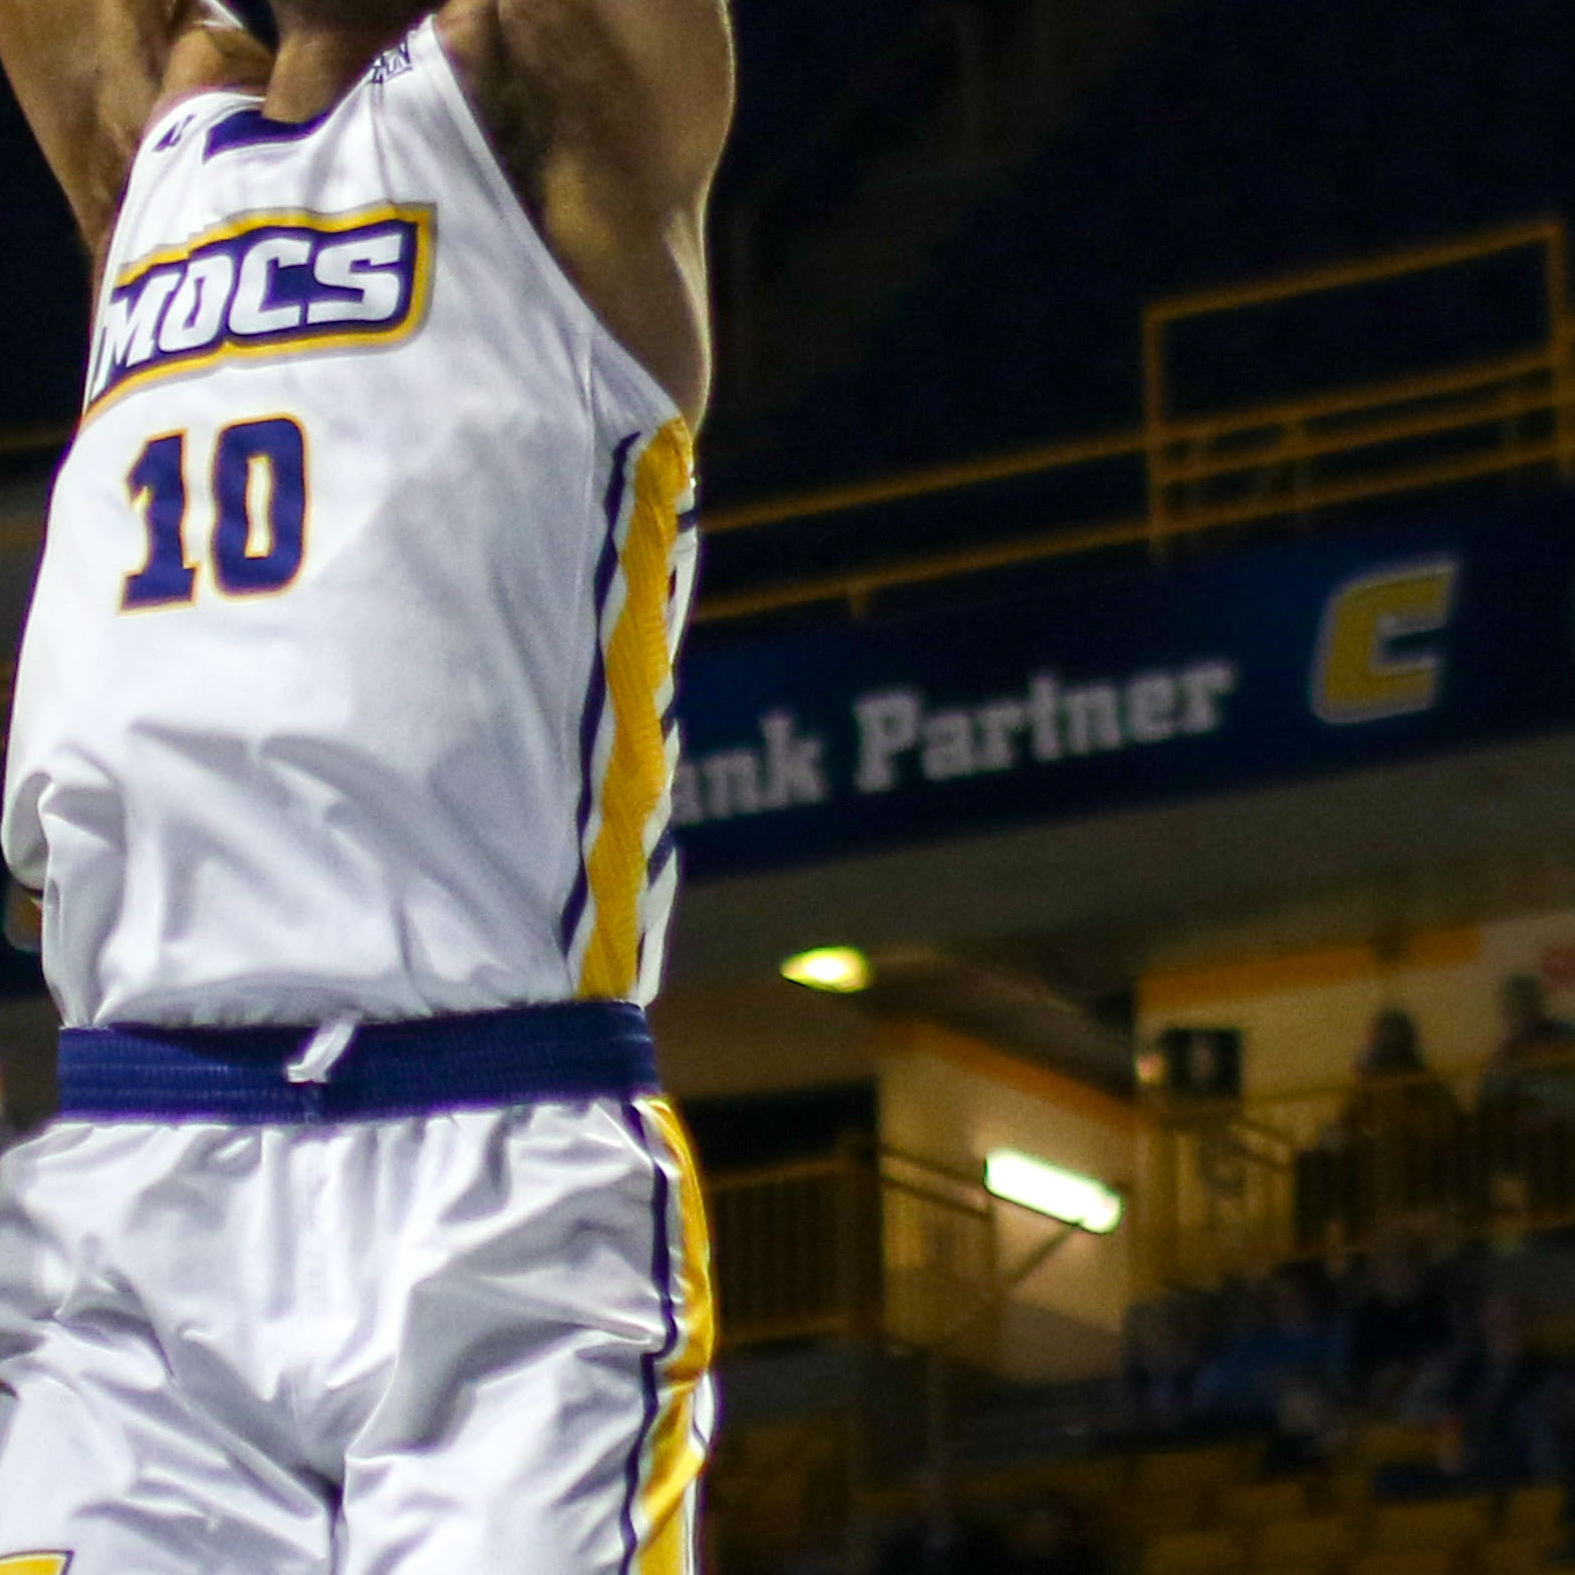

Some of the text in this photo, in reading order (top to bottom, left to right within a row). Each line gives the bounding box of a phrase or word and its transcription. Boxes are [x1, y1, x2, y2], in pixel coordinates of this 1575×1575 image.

[89, 231, 405, 405] MOCS
[115, 412, 311, 615] 10
[851, 661, 1237, 796] Partner
